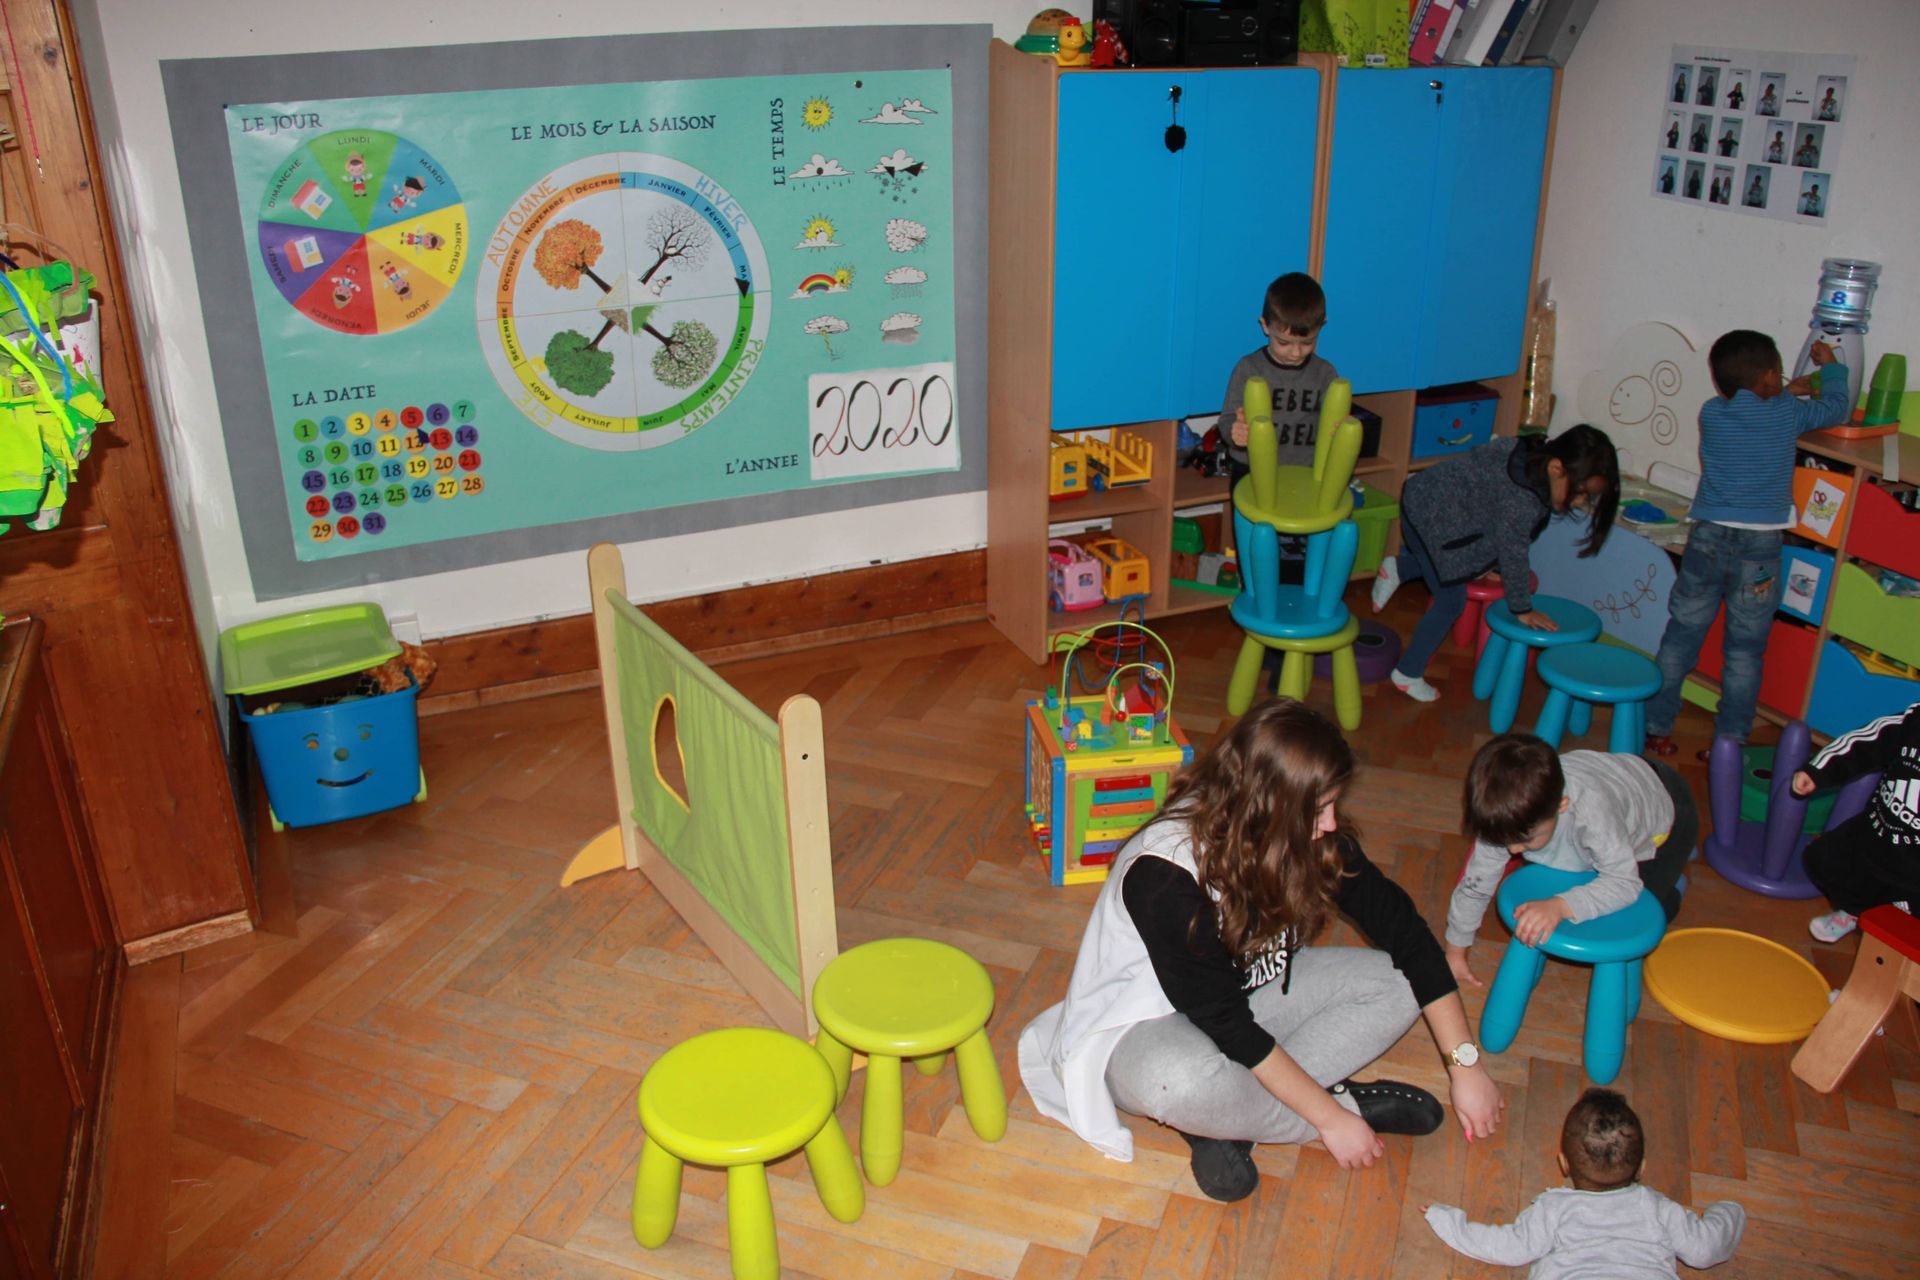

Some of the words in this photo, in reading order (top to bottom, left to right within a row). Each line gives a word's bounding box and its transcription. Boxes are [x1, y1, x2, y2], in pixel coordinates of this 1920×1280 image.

[242, 117, 265, 133] LE
[270, 113, 323, 136] JOUR
[511, 126, 532, 141] LE
[540, 121, 587, 139] MOIS
[593, 119, 614, 136] &
[620, 119, 643, 134] LA
[649, 115, 717, 133] SAISON
[770, 97, 785, 161] TEMPS
[337, 136, 370, 146] LUNDI
[268, 159, 303, 208] DIMANCHE
[419, 158, 446, 187] MARDI
[773, 166, 786, 186] LE
[694, 175, 748, 232] HIVER
[487, 176, 559, 268] AUTOMNE
[448, 222, 463, 275] MERCREDI
[405, 300, 431, 321] JEUDI
[1831, 291, 1847, 305] 8
[292, 391, 317, 407] LA
[324, 385, 377, 403] DATE
[680, 339, 765, 434] PRINTEMPS
[1272, 388, 1321, 412] EBEL
[302, 424, 309, 437] 1
[327, 421, 338, 434] 2
[355, 417, 365, 431] 3
[380, 414, 391, 427] 4
[407, 411, 417, 424] 5
[432, 408, 442, 421] 6
[458, 405, 468, 418] 7
[812, 374, 953, 458] 2020
[305, 450, 315, 464] 8
[331, 446, 341, 460] 9
[352, 442, 372, 457] 10
[380, 439, 396, 453] 11
[406, 435, 424, 449] 12
[431, 432, 450, 446] 13
[457, 429, 476, 443] 14
[1273, 423, 1316, 446] BEL
[305, 474, 324, 489] 15
[331, 471, 350, 485] 16
[357, 467, 375, 481] 17
[383, 464, 402, 477] 18
[410, 460, 427, 474] 19
[434, 456, 453, 470] 20
[460, 453, 478, 466] 21
[726, 454, 799, 476] L'ANNEE
[308, 500, 328, 514] 22
[334, 495, 354, 510] 23
[360, 492, 380, 506] 24
[386, 488, 406, 503] 25
[412, 484, 432, 498] 26
[437, 481, 455, 495] 27
[463, 477, 482, 491] 28
[312, 524, 332, 538] 29
[338, 520, 358, 534] 30
[365, 516, 384, 530] 31
